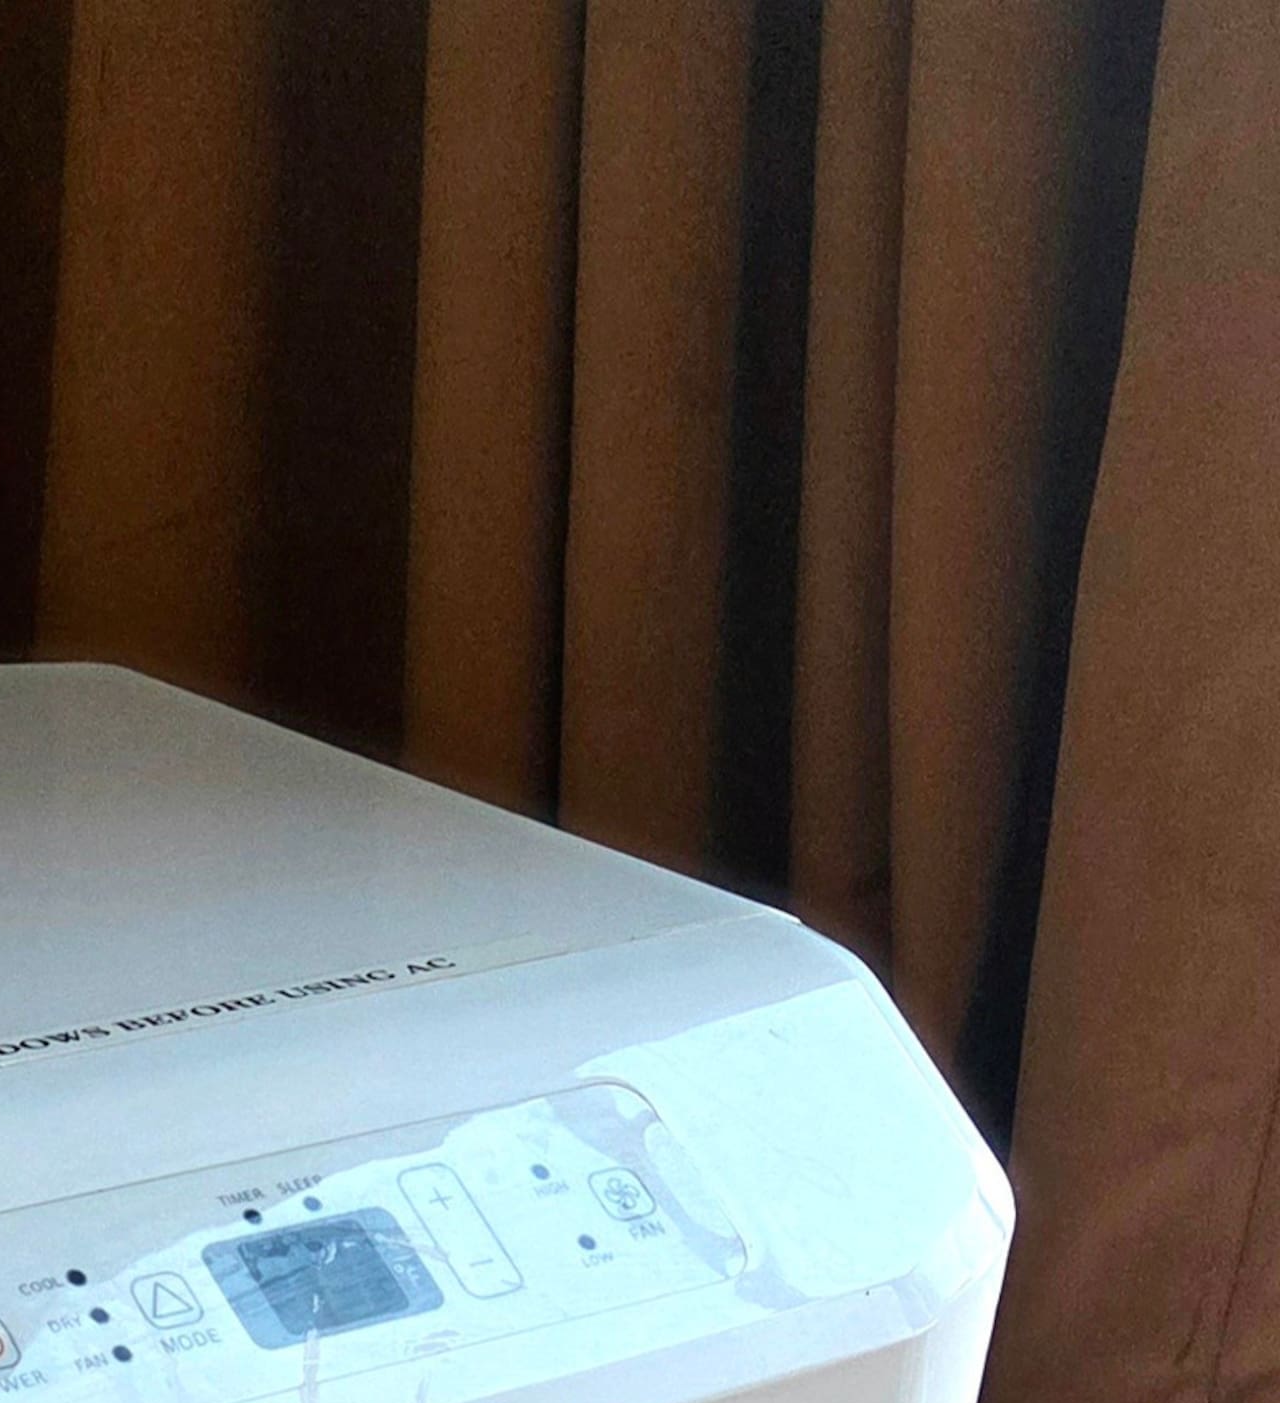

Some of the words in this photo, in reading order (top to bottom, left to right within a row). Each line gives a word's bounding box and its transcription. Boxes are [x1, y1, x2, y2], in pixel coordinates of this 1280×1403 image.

[116, 993, 277, 1033] BEFORE
[275, 967, 397, 1001] USING
[406, 956, 457, 978] AC
[276, 1174, 322, 1196] SLEEP
[217, 1187, 265, 1207] TIMER
[628, 1220, 666, 1240] FAN
[581, 1252, 614, 1269] LOW
[18, 1277, 64, 1298] COOL
[47, 1312, 82, 1334] DRY
[159, 1327, 221, 1355] MODE
[74, 1353, 109, 1374] FAN
